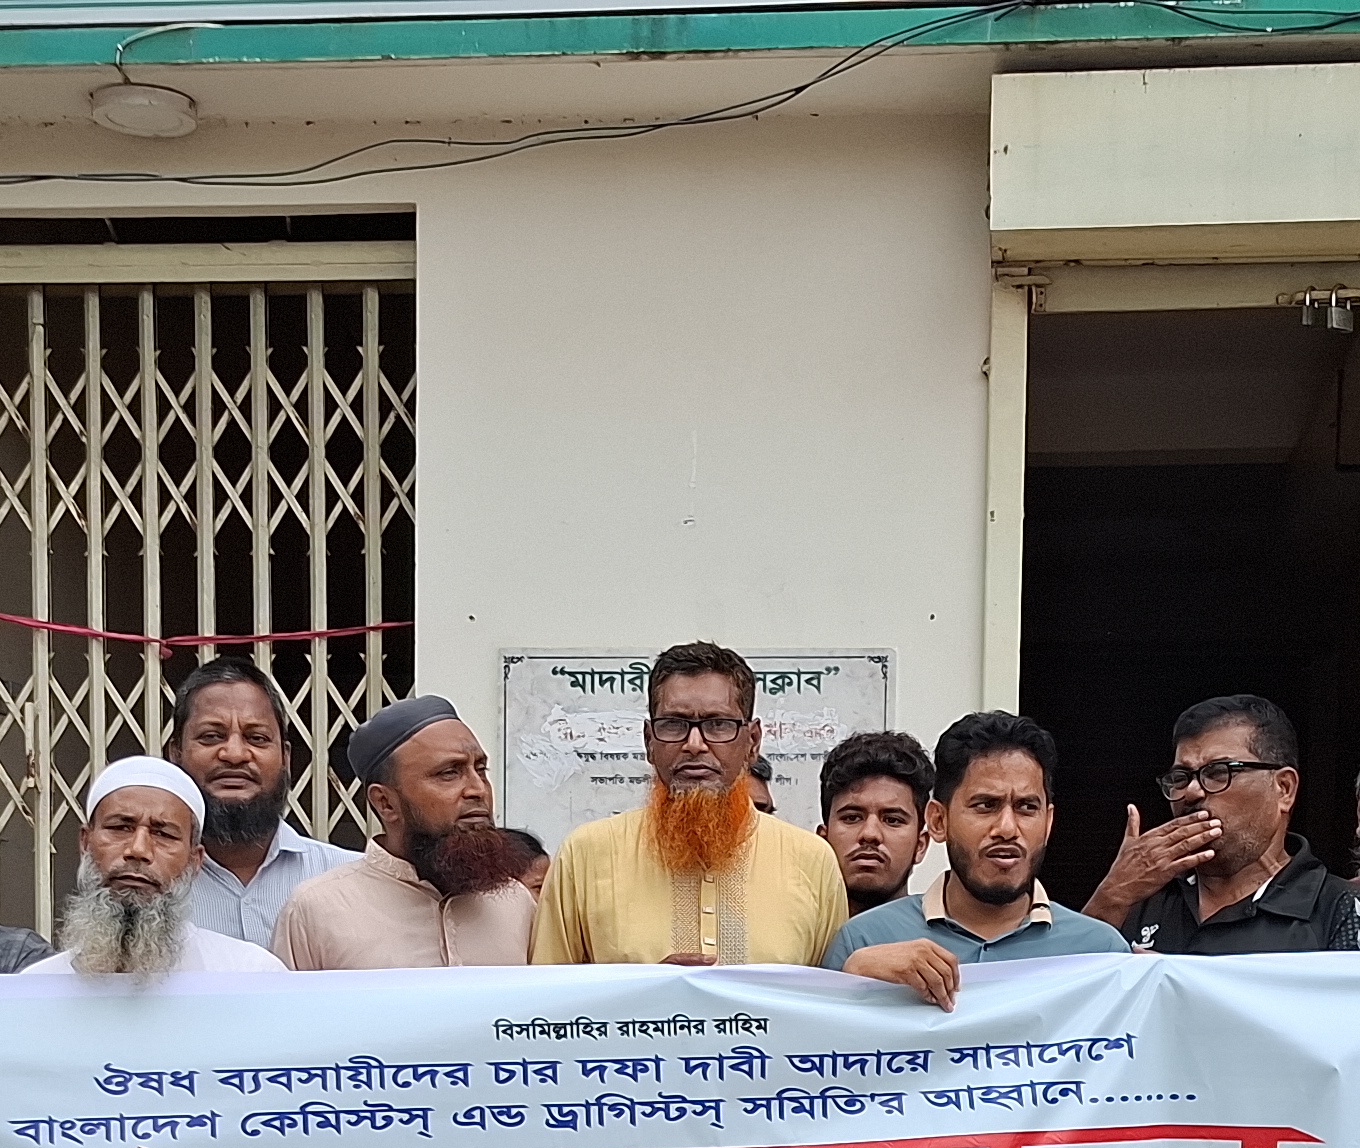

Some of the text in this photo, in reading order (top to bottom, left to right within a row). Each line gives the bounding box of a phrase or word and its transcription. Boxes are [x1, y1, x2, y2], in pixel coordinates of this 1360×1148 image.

[492, 1013, 770, 1041] বিসমিল্লাহির রাহমানির রাহিম
[93, 1031, 1137, 1098] ঔষধ ব্যবসায়ীদের চার দফা দাবী আদায়ে সারাদেশে
[13, 1109, 222, 1146] বাংলাদেশ
[240, 1100, 436, 1139] কেমিস্টস্
[453, 1104, 530, 1132] এন্ড
[540, 1091, 726, 1132] ড্রাগিস্টস্
